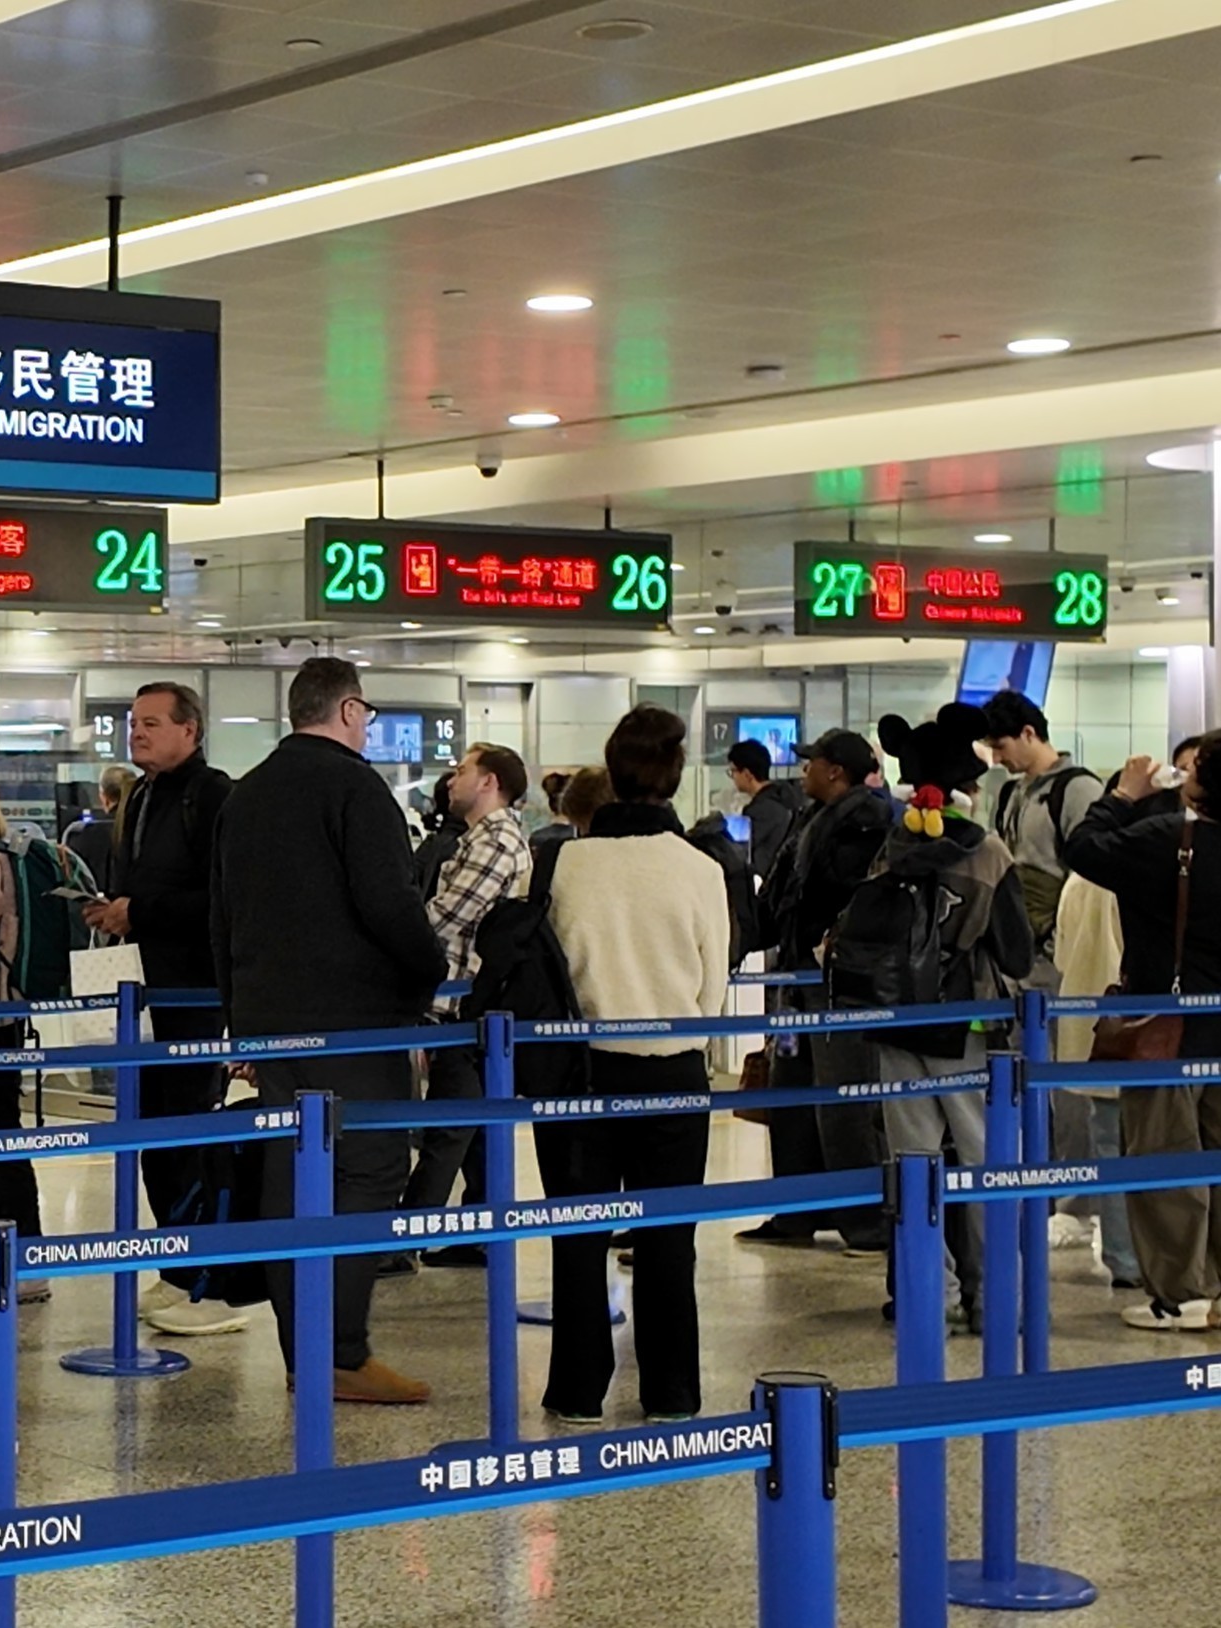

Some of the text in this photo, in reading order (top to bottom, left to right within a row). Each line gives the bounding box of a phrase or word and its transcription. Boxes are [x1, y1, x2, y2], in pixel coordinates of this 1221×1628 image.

[95, 530, 162, 592] 24
[325, 542, 385, 601] 25
[612, 554, 667, 610] 26
[812, 562, 863, 617] 27
[1054, 571, 1103, 624] 28
[93, 715, 114, 736] 15
[436, 719, 455, 740] 16
[713, 722, 729, 741] 17
[254, 1111, 300, 1130] 中国移
[6, 1132, 89, 1152] IMMIGRATION
[982, 1166, 1098, 1188] CHINA IMMIGRATION
[392, 1211, 494, 1237] 中国移民管理
[504, 1201, 643, 1228] CHINA IMMIGRATION
[25, 1235, 190, 1265] CHINA IMMIGRATION
[599, 1437, 670, 1469] CHINA
[420, 1446, 581, 1493] 中国移民管理
